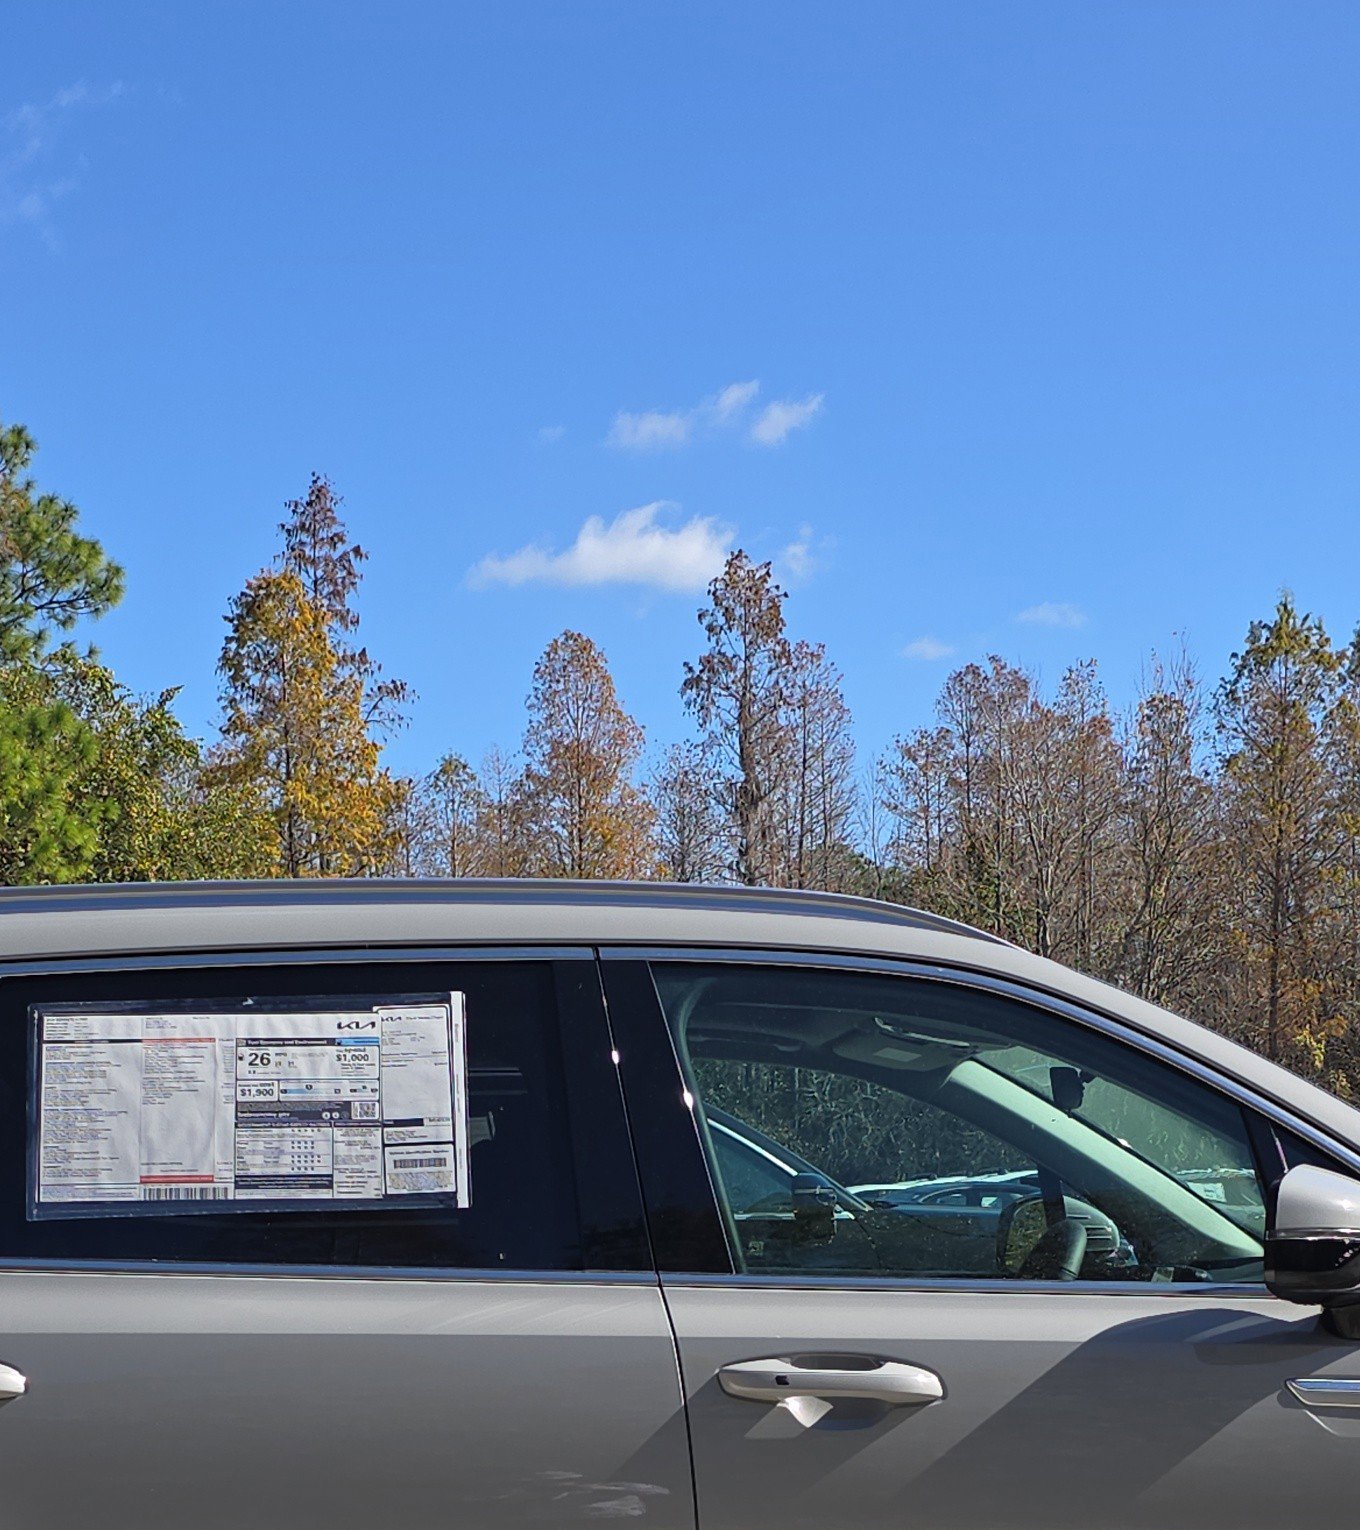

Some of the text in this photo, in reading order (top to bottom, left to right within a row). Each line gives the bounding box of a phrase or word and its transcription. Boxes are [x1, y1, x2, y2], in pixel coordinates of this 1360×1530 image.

[336, 1020, 376, 1030] KIA
[247, 1052, 271, 1066] 26
[335, 1053, 370, 1063] $1,000
